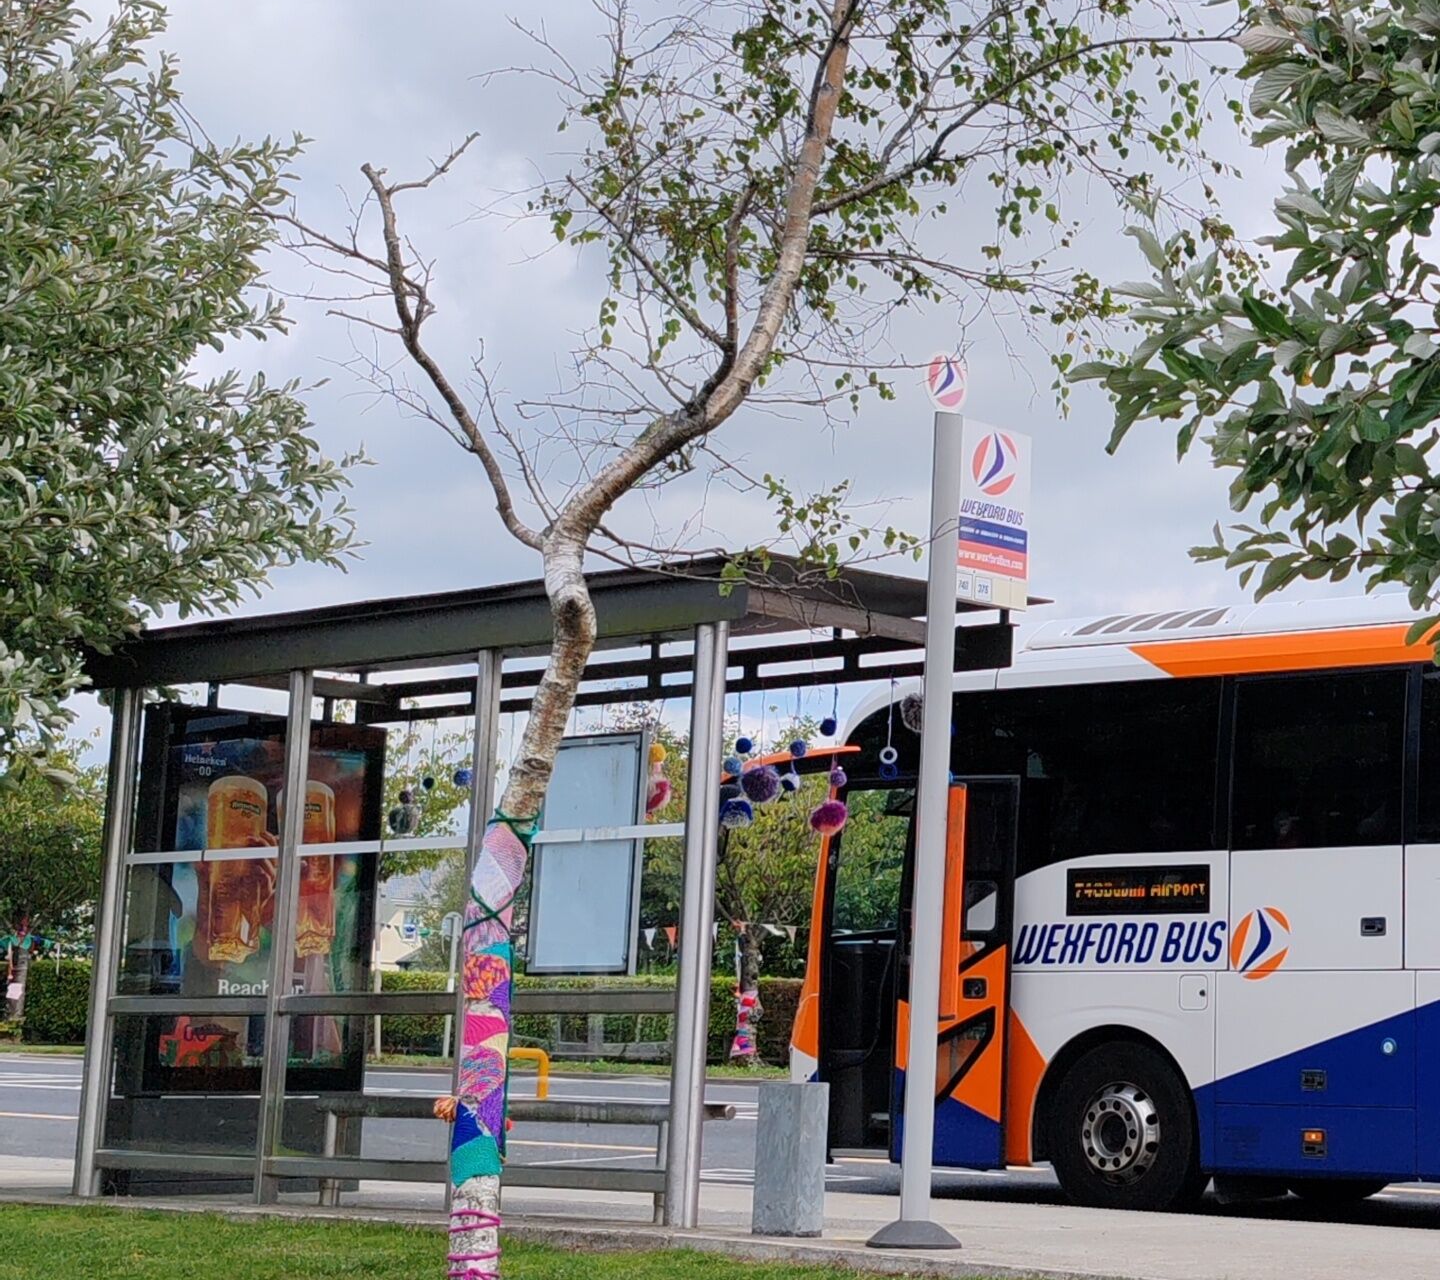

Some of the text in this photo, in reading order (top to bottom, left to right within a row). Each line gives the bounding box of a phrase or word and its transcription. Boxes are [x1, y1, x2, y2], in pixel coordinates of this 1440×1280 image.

[1006, 509, 1025, 526] BUS
[1013, 921, 1227, 965] WEXFORD BUS
